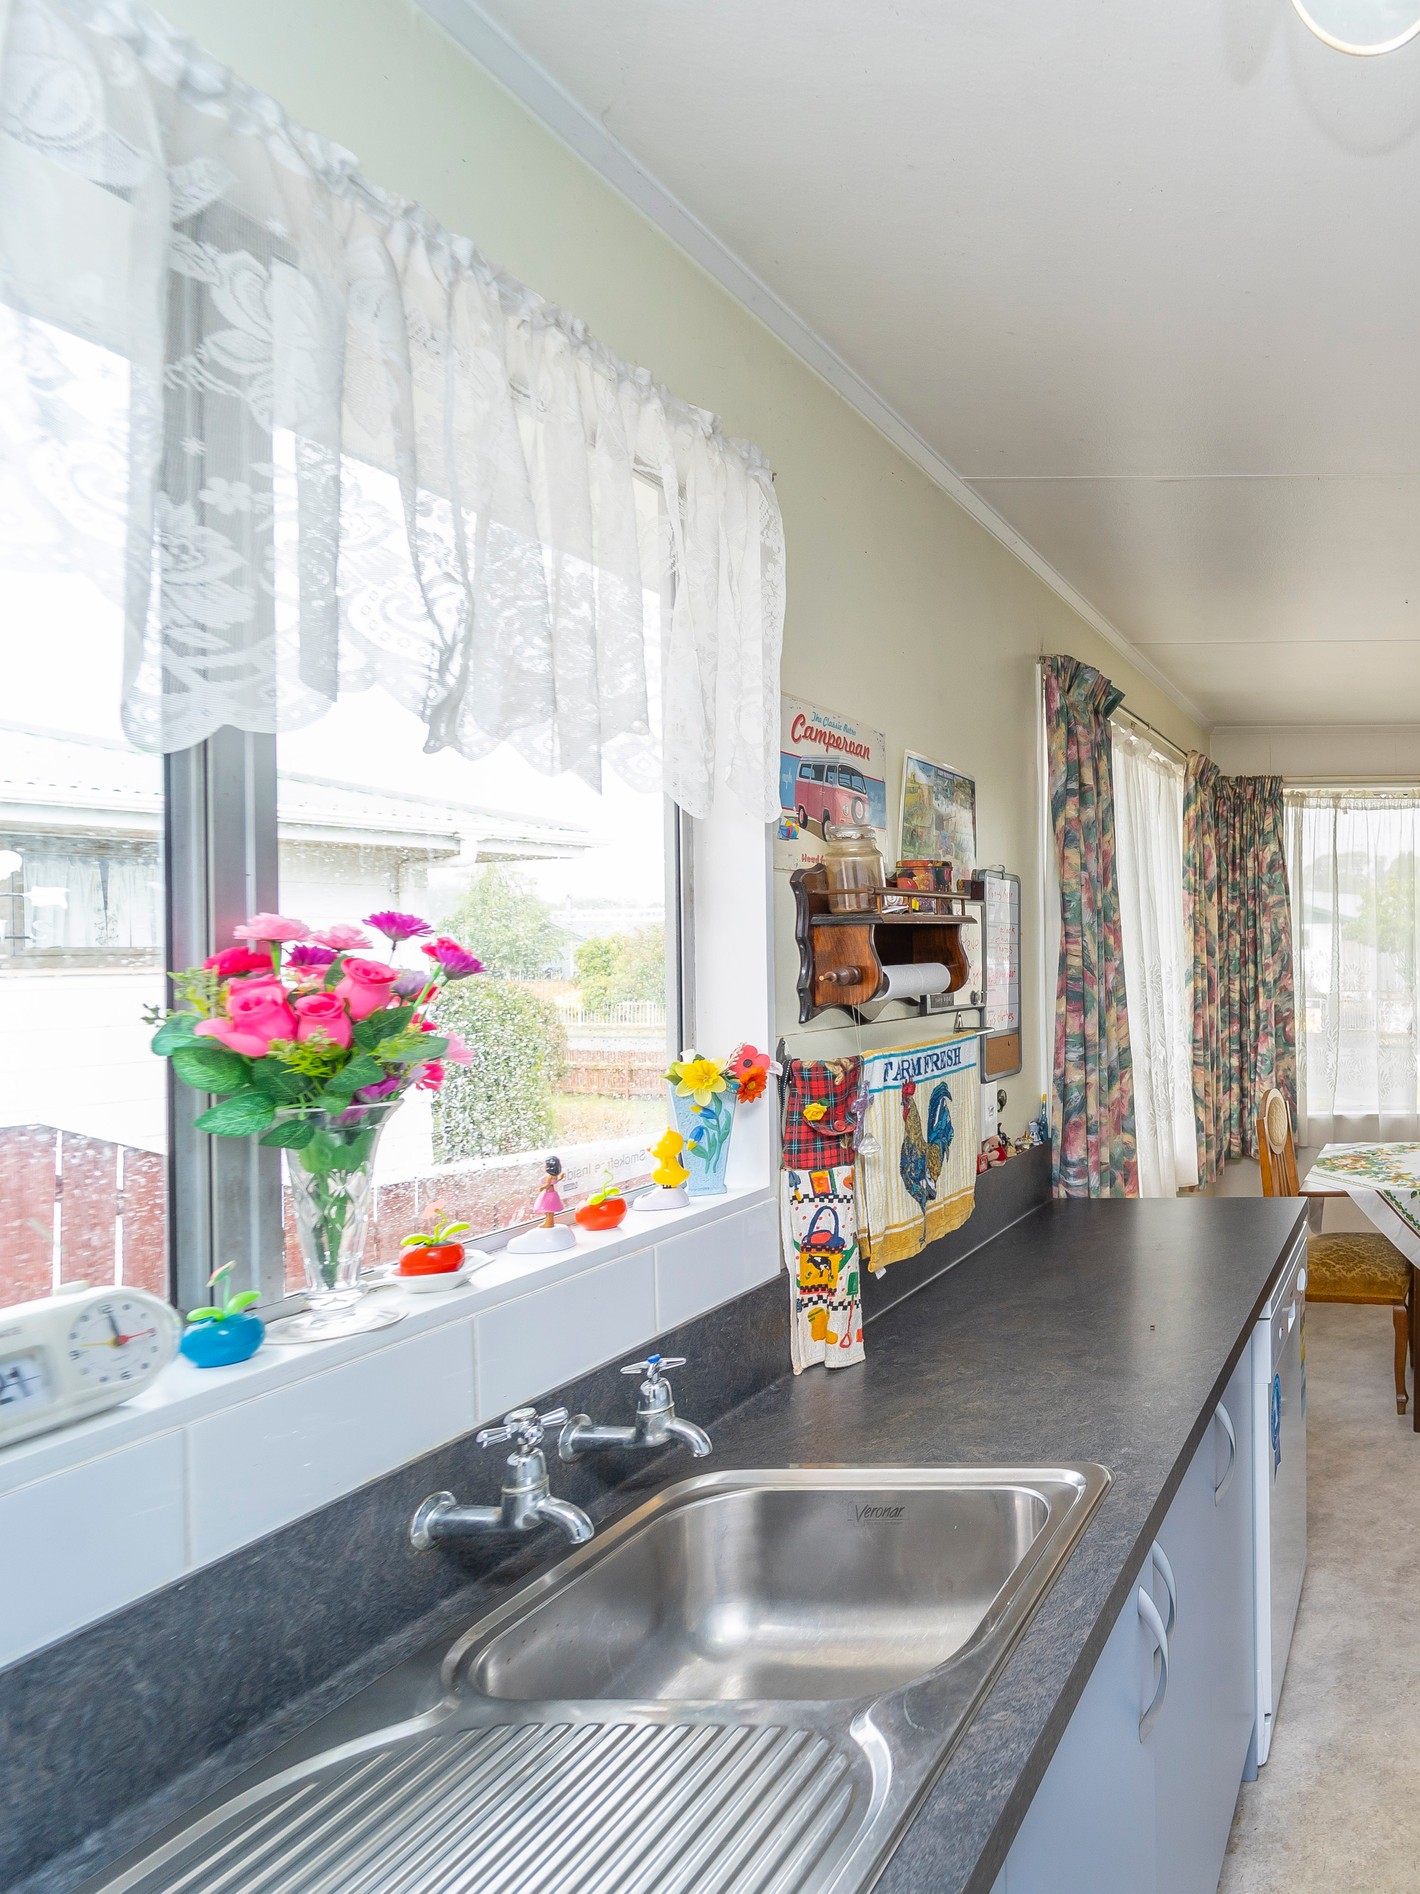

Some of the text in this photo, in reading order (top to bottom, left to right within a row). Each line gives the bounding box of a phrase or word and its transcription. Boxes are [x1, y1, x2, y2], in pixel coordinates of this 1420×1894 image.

[790, 713, 871, 761] Campervan
[811, 711, 822, 724] The
[822, 716, 843, 731] Classic
[883, 1047, 962, 1082] FARM FRESH
